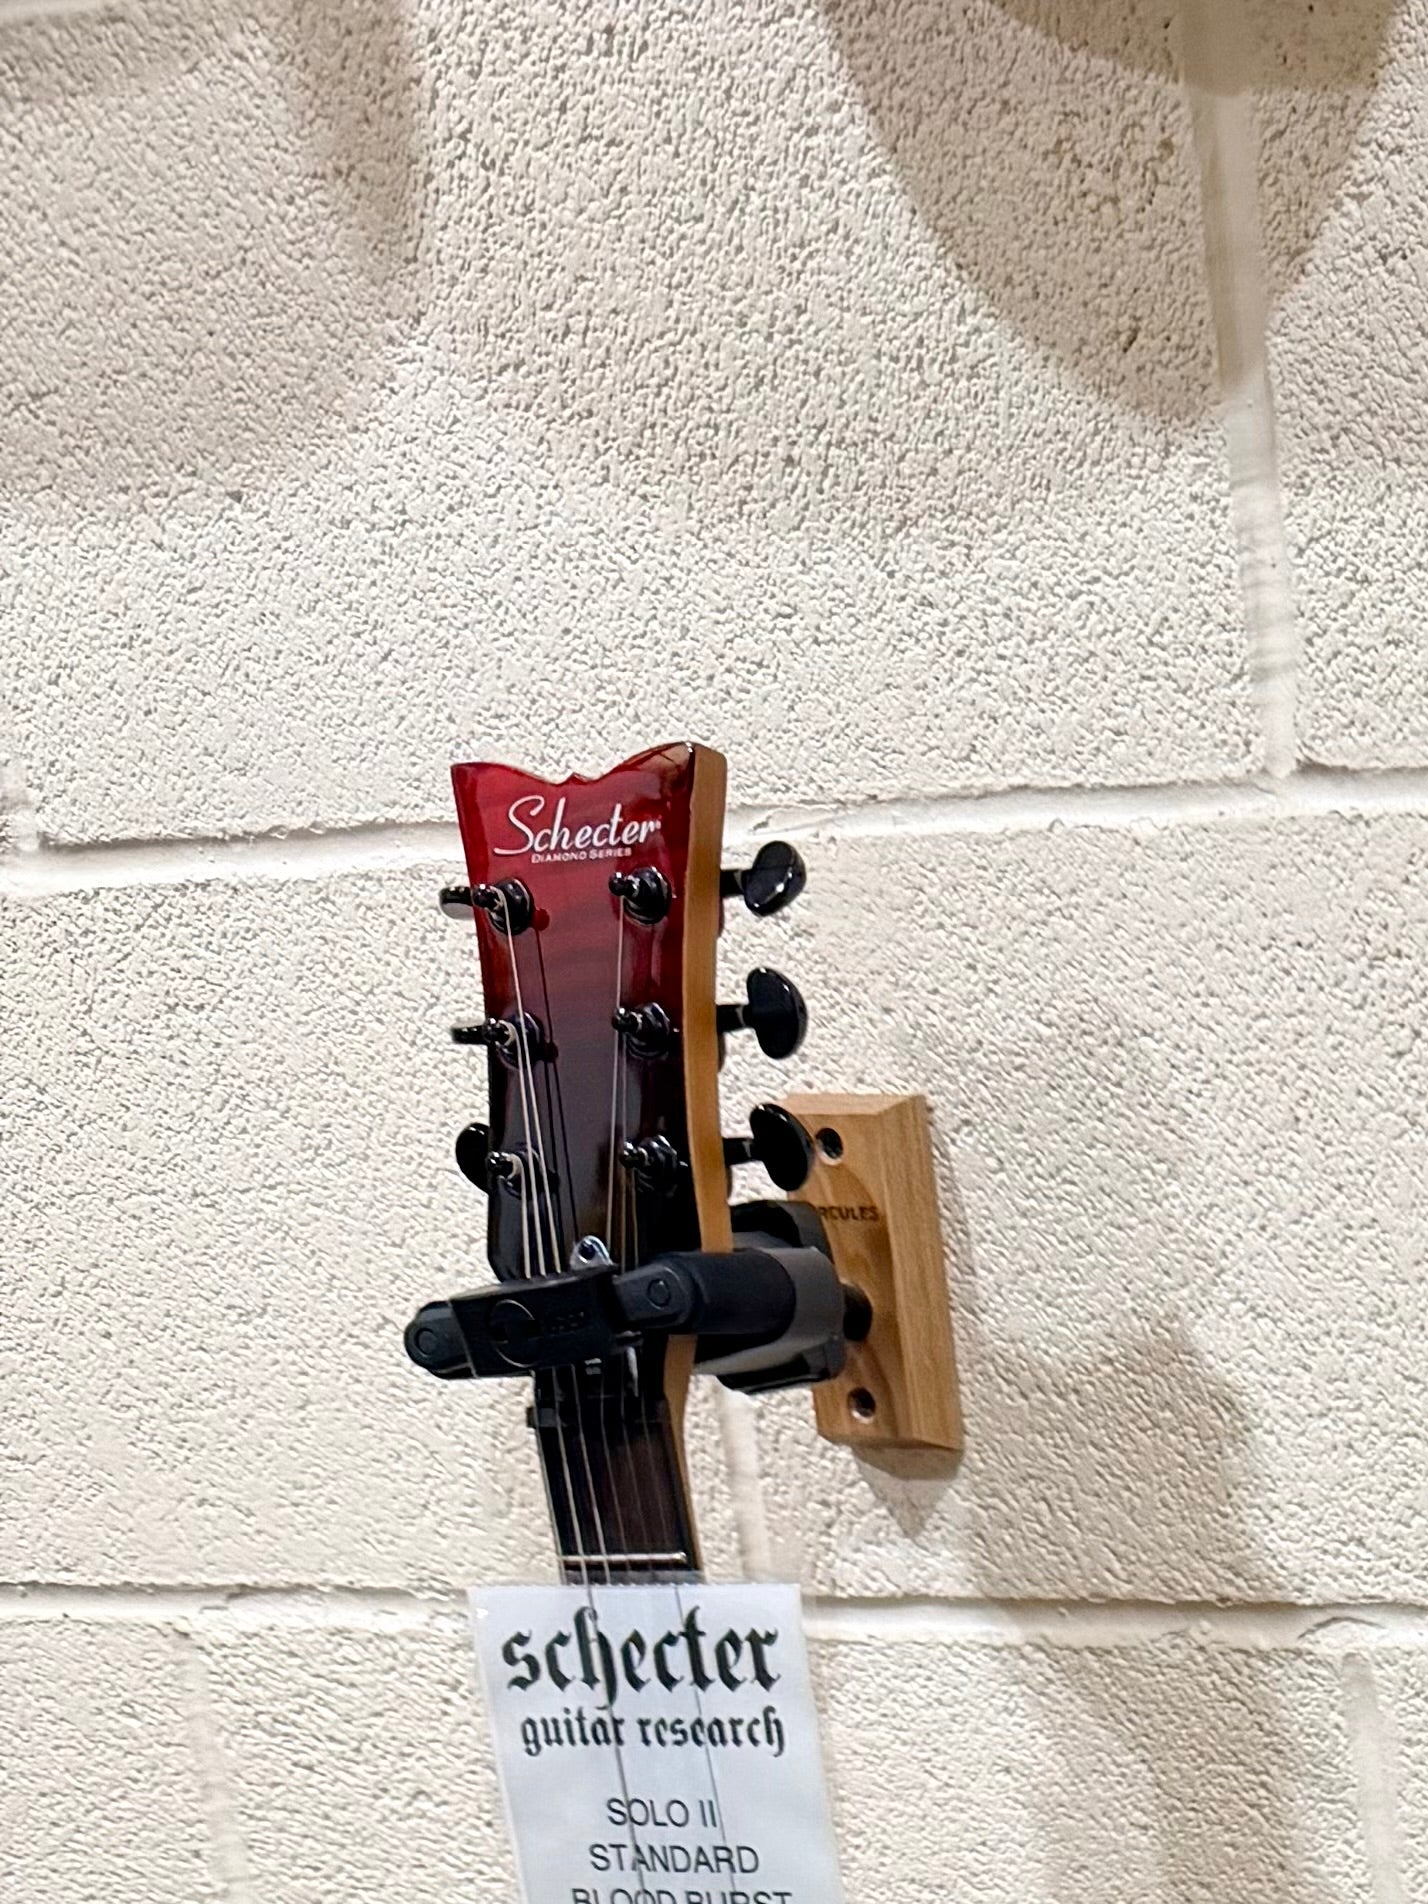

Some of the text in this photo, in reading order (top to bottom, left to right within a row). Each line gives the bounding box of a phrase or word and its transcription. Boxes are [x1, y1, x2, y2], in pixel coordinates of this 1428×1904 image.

[531, 846, 632, 864] DIAMOND SERIES
[501, 1605, 782, 1707] schecter
[520, 1705, 786, 1758] guitar research
[606, 1797, 718, 1829] SOLO II
[588, 1842, 760, 1874] STANDARD
